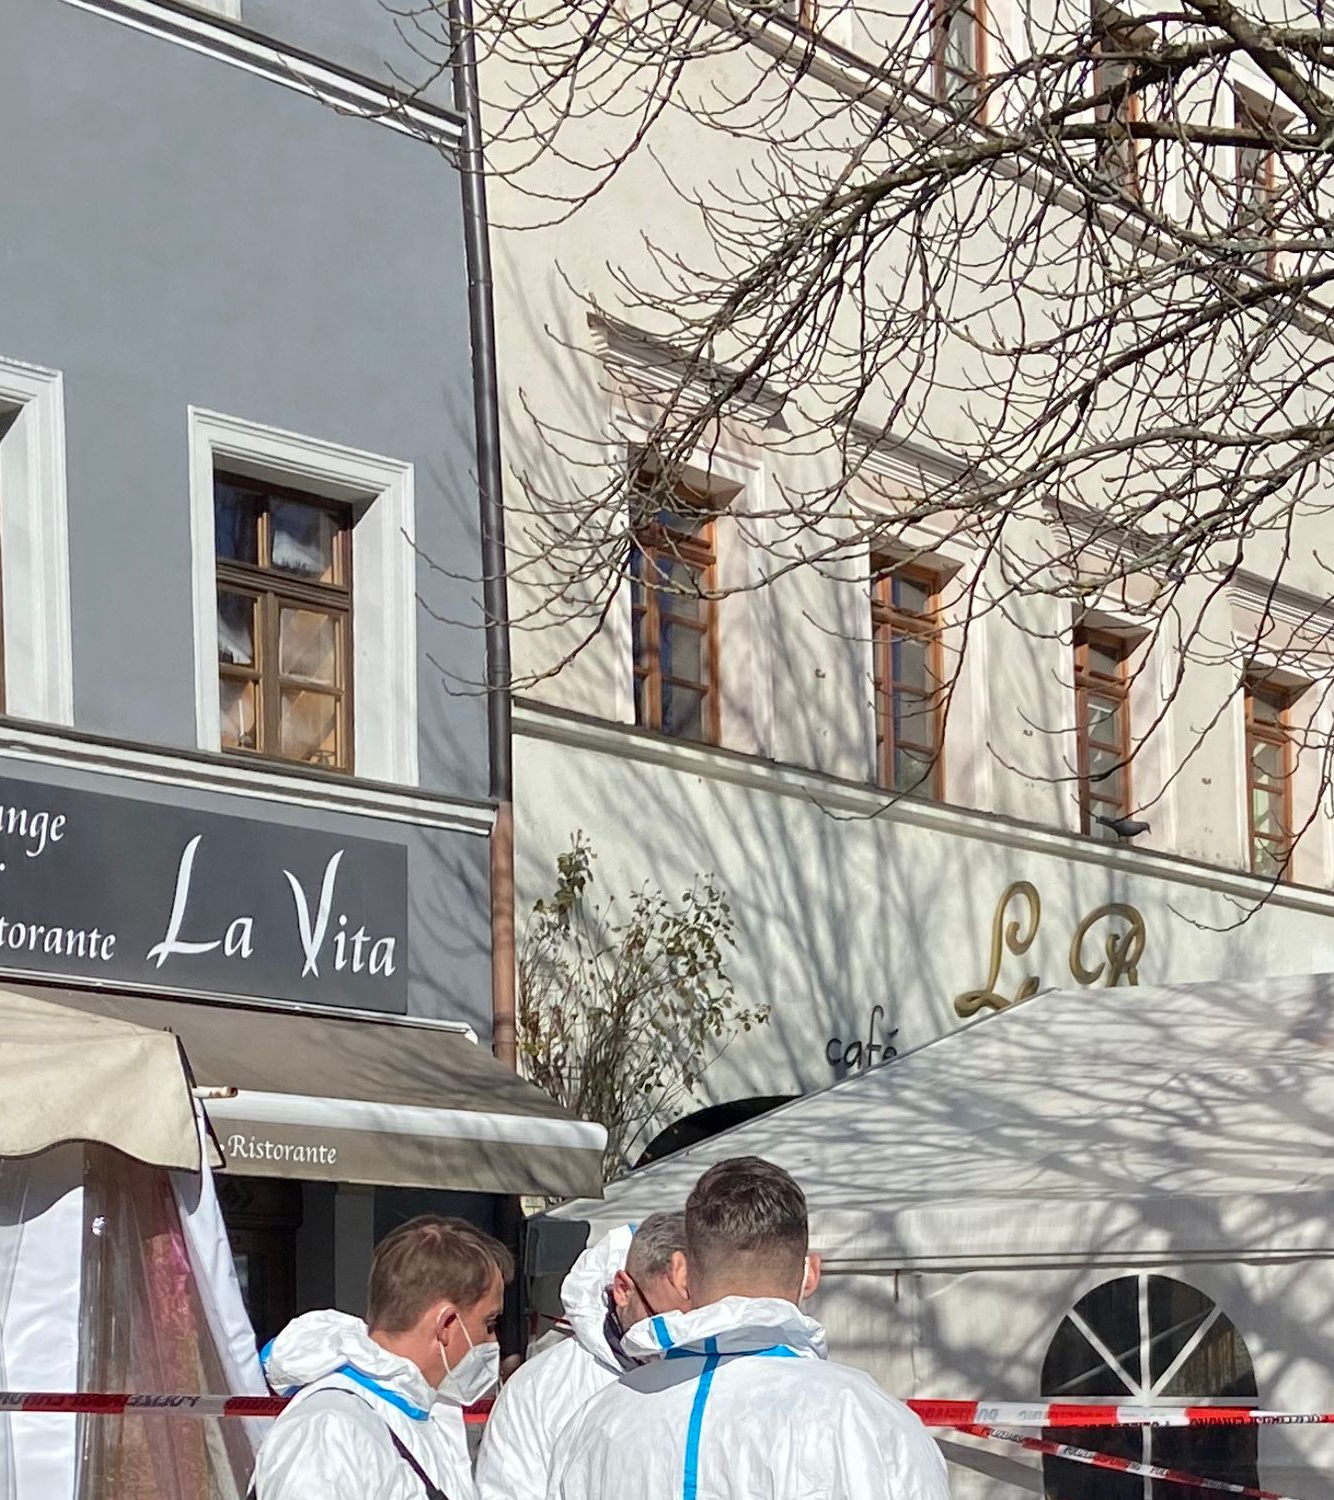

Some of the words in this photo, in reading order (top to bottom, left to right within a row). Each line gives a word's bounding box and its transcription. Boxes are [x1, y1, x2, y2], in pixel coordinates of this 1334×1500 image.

[146, 834, 254, 969] La
[282, 849, 397, 978] Vita
[229, 1134, 337, 1164] Ristorante
